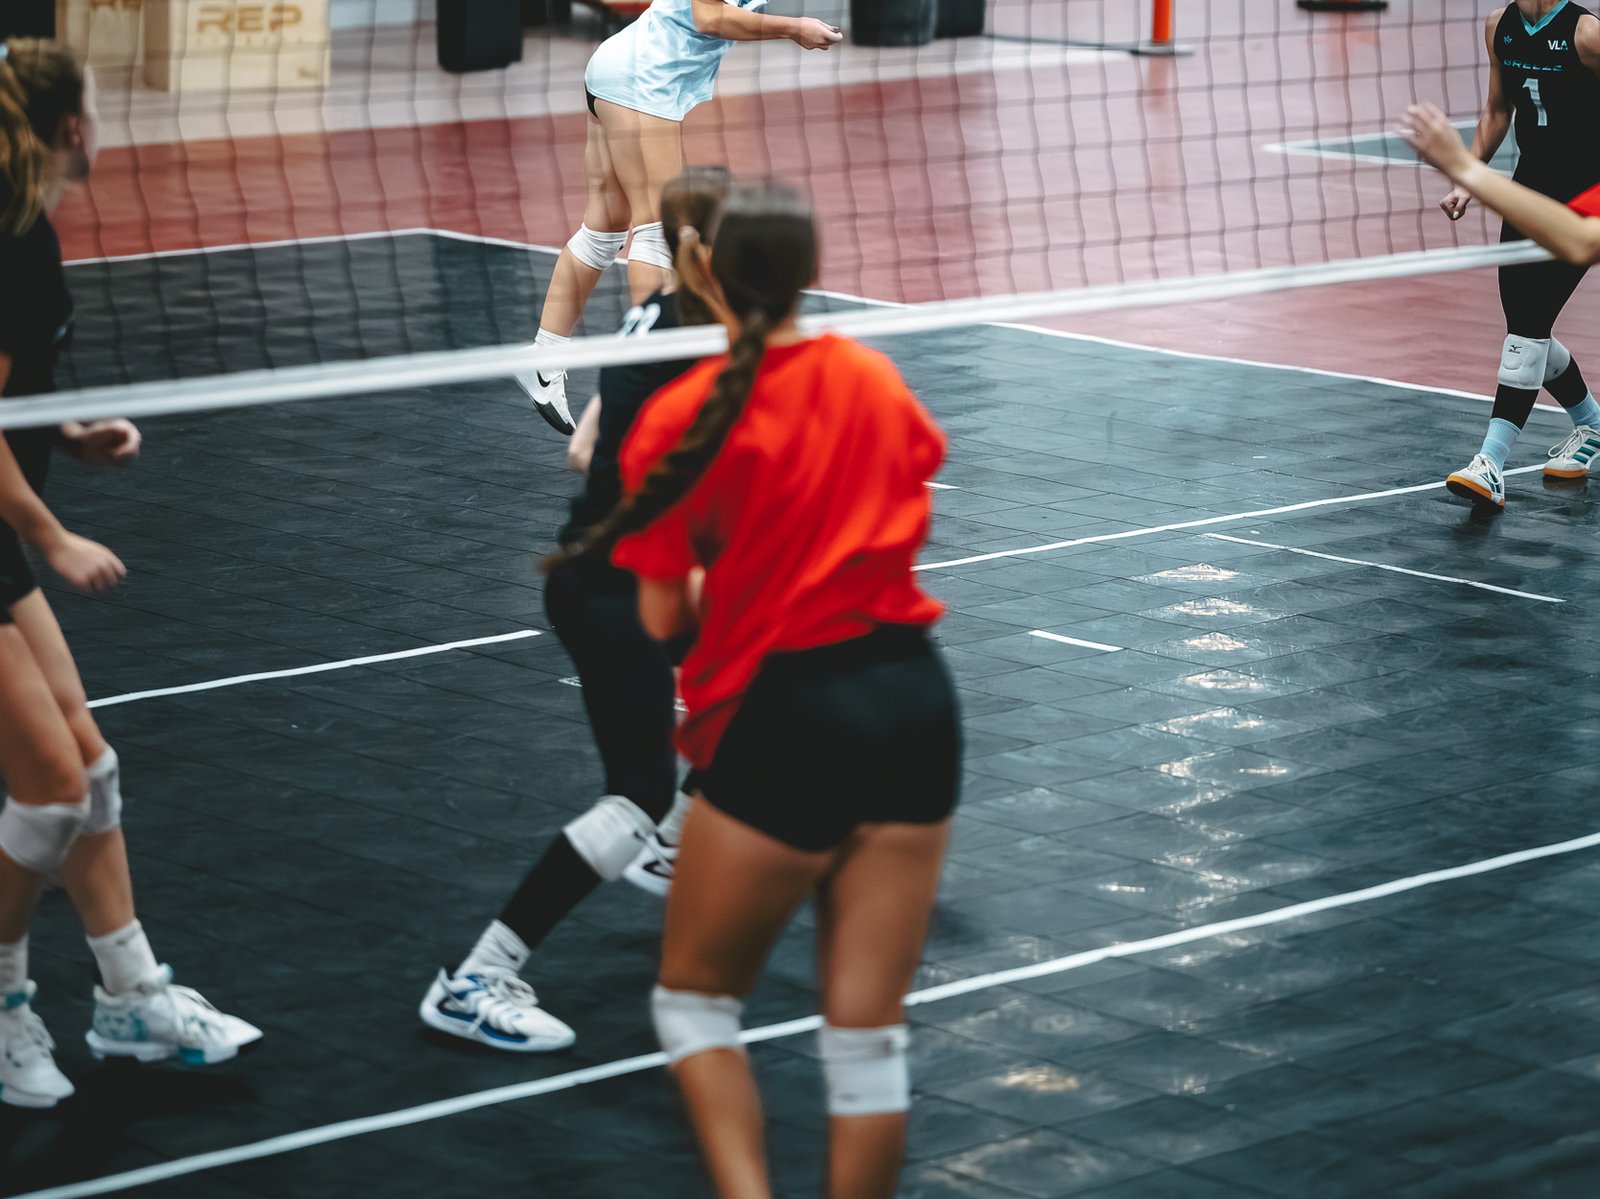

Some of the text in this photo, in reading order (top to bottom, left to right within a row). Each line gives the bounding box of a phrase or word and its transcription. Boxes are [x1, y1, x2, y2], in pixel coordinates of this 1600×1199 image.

[196, 4, 304, 33] REP
[1547, 39, 1568, 51] VLA
[1522, 77, 1548, 126] 1
